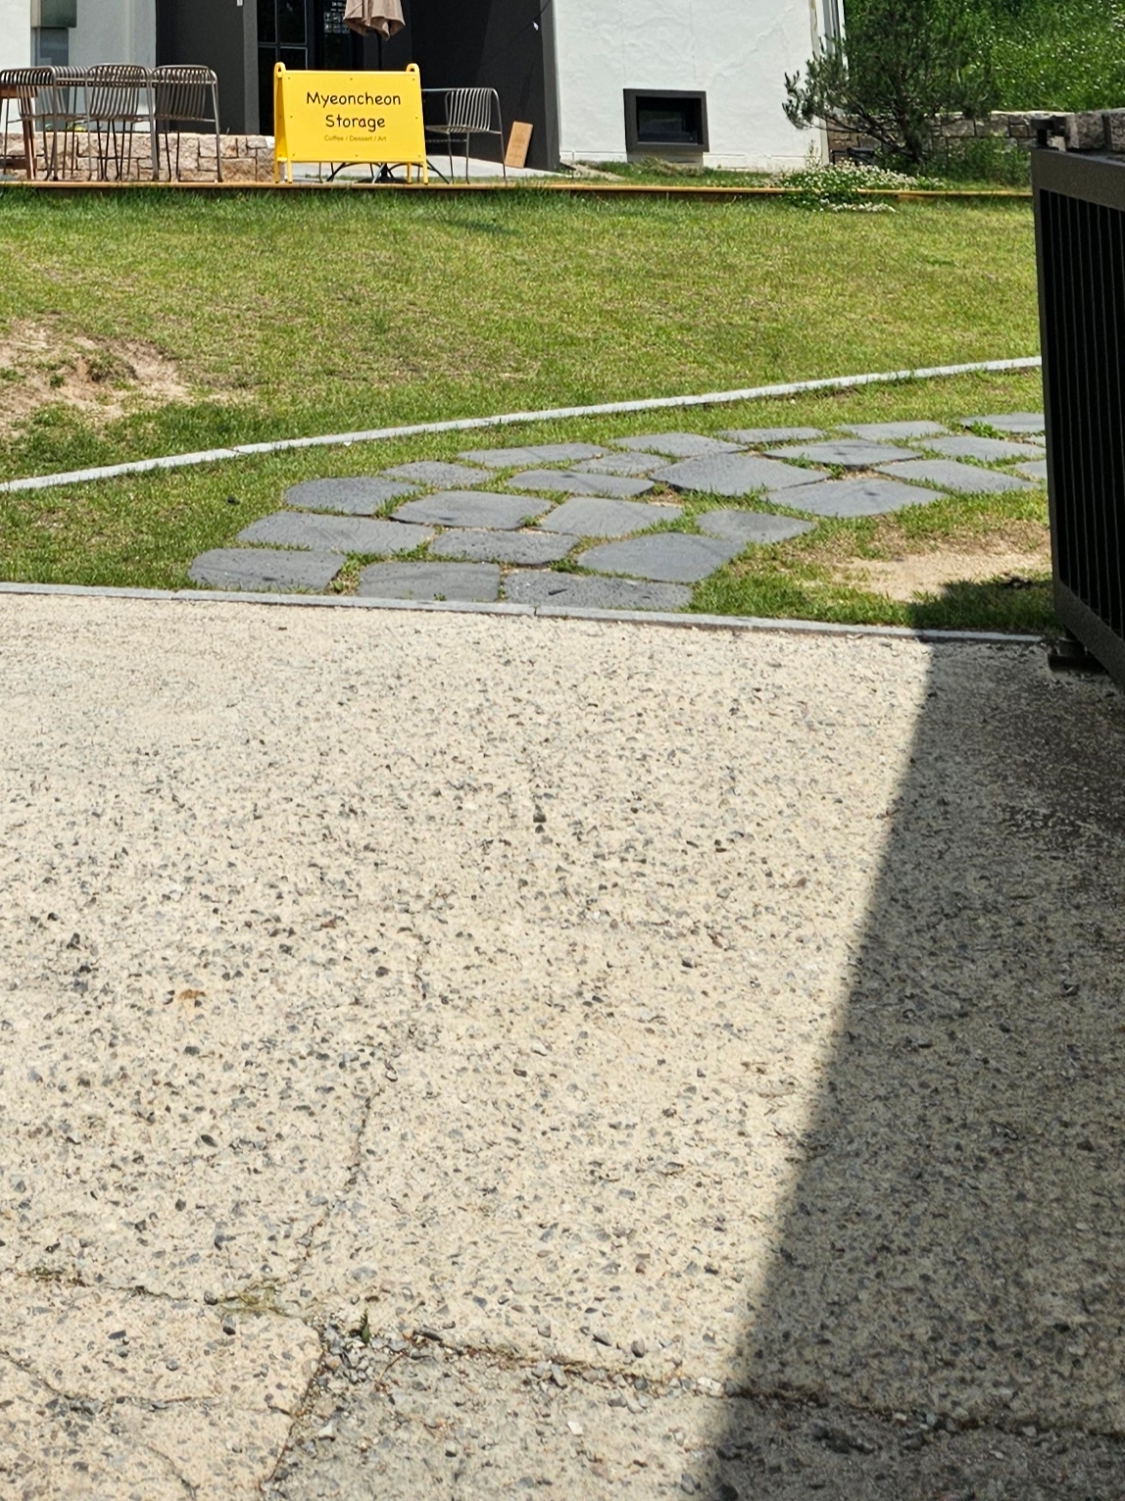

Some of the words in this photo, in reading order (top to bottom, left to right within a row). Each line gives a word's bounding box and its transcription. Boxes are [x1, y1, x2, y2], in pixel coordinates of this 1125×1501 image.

[306, 92, 401, 108] Myeoncheon
[325, 114, 386, 133] Storage
[324, 134, 344, 142] Coffee
